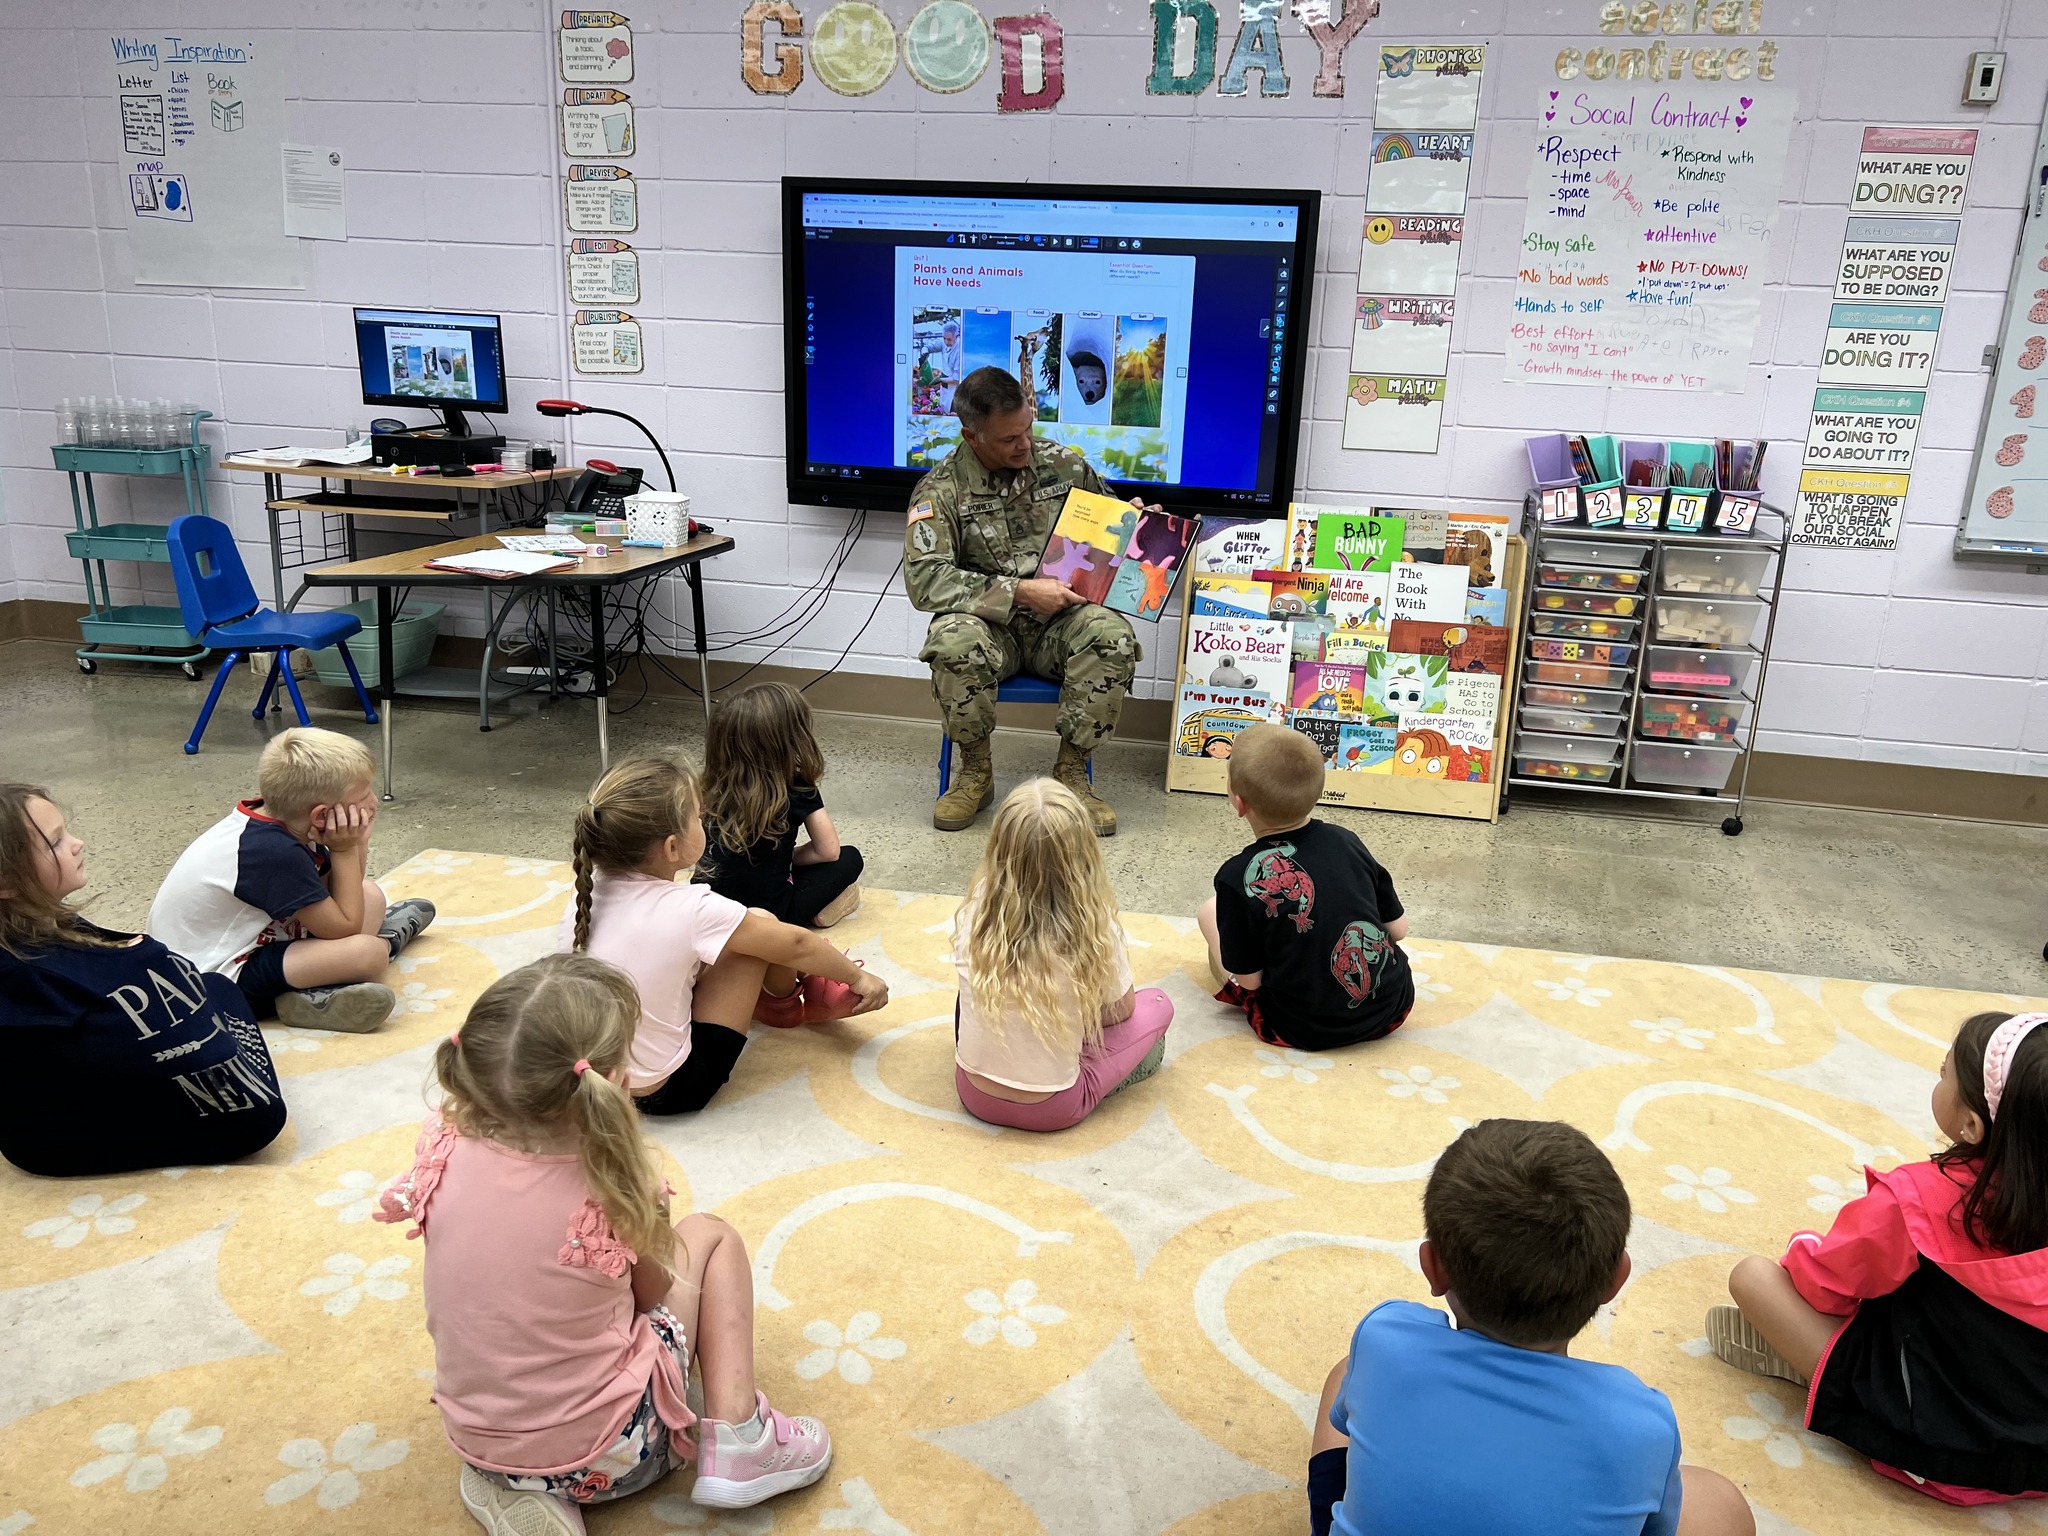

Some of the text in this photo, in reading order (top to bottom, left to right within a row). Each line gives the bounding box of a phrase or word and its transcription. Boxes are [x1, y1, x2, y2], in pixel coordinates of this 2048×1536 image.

[579, 14, 611, 24] PREWRITE
[111, 37, 254, 72] Writing Inspiration:
[740, 0, 1380, 113] GOOD DAY
[1555, 39, 1779, 82] contract
[118, 72, 238, 90] Letter Book
[171, 70, 190, 84] List
[585, 92, 607, 100] DRAFT
[1570, 92, 1731, 128] Social Contract
[1417, 135, 1473, 151] HEART
[1672, 146, 1754, 168] Respond with
[137, 160, 163, 172] map
[589, 169, 611, 177] REVISE
[1861, 161, 1966, 176] WHAT ARE YOU
[1560, 170, 1592, 183] time
[1678, 166, 1726, 184] Kindness
[1557, 187, 1591, 201] space
[1855, 182, 1963, 204] DOING??
[1556, 204, 1586, 218] mind
[1661, 199, 1720, 219] Be polite
[1655, 225, 1717, 244] attentive
[594, 242, 608, 250] EDIT
[1526, 232, 1597, 256] Stay safe
[1846, 249, 1950, 263] WHAT ARE YOU
[913, 263, 1024, 277] Plants and Animals
[1649, 259, 1665, 273] NO
[1842, 264, 1943, 281] SUPPOSED
[913, 276, 981, 288] Have Needs
[1522, 268, 1609, 286] No bad words
[1840, 283, 1939, 297] TO BE DOING?
[1517, 298, 1605, 313] Hands to self
[1639, 290, 1693, 307] Have fun!
[1514, 323, 1595, 341] Best effort
[1845, 333, 1911, 346] ARE YOU
[1530, 342, 1543, 351] no
[1547, 343, 1580, 359] saying
[1824, 349, 1930, 369] DOING IT?
[1524, 359, 1562, 374] Growth
[1632, 373, 1658, 384] power
[1663, 374, 1674, 384] of
[1681, 375, 1706, 387] YET
[1387, 379, 1437, 395] MATH
[1814, 414, 1916, 430] WHAT ARE YOU
[1824, 430, 1898, 444] GOING TO
[1808, 447, 1910, 462] DO ABOUT IT?
[1051, 482, 1071, 495] ARMY
[1803, 492, 1898, 506] WHAT IS GOING
[968, 502, 994, 513] POIRIER
[1555, 491, 1749, 528] 1 2 3 4 5
[1809, 502, 1889, 517] TO HAPPEN
[1420, 511, 1443, 520] Goes
[1804, 513, 1892, 527] IF YOU BREAK
[1236, 531, 1260, 541] WHEN
[1343, 520, 1381, 539] BAD
[1803, 524, 1885, 537] OUR SOCIAL
[1334, 536, 1387, 556] BUNNY
[1792, 534, 1895, 548] CONTRACT AGAIN?
[1236, 555, 1254, 564] MET
[1399, 567, 1423, 580] The
[1297, 577, 1325, 594] Ninja
[1329, 577, 1363, 590] All Are
[1397, 583, 1428, 595] Book
[1204, 601, 1221, 616] My
[1395, 598, 1426, 610] With
[1209, 622, 1234, 632] Little
[1193, 630, 1285, 655] Koko Bear
[1327, 638, 1342, 649] Fill
[1353, 638, 1385, 652] Bucket
[1317, 676, 1350, 692] LOVE
[1458, 678, 1495, 689] Pigeon
[1184, 691, 1267, 707] I'm Your Bus
[1459, 689, 1494, 699] HAS to
[1449, 707, 1492, 717] School!
[1297, 720, 1332, 731] On the
[1404, 717, 1475, 729] Kindergarten
[1306, 731, 1325, 740] Day
[1346, 729, 1383, 737] FROGGY
[1449, 730, 1489, 746] ROCKS!
[172, 1054, 280, 1116] NEW
